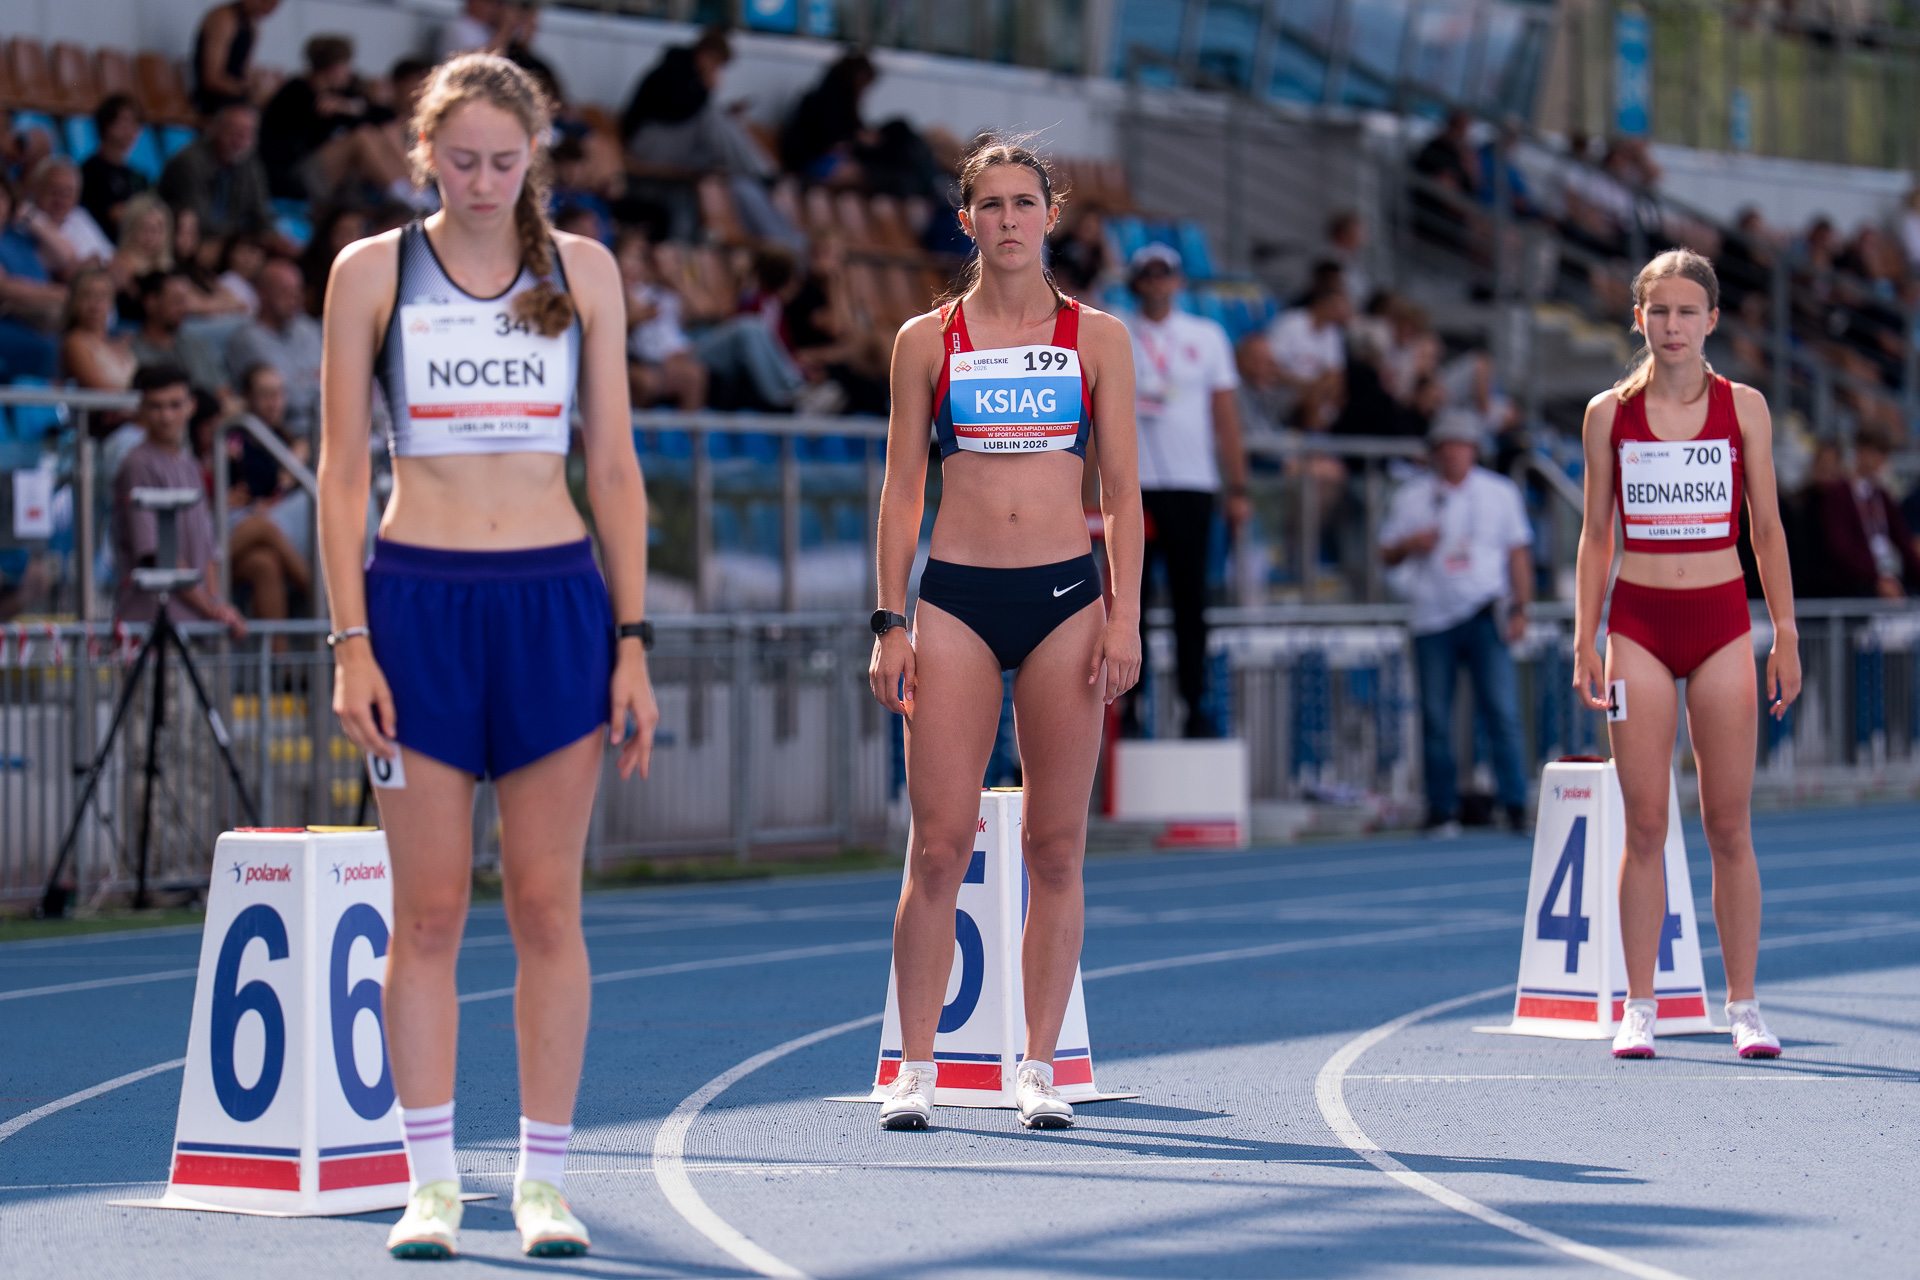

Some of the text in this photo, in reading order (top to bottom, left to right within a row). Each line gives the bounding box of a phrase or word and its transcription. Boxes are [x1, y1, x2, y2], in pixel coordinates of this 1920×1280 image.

[428, 353, 544, 387] NOCEŃ
[973, 357, 1009, 365] LUBELSKIE
[1023, 351, 1068, 371] 199
[975, 388, 1056, 418] KSIĄG
[983, 440, 1048, 449] LUBLIN 2026
[1683, 446, 1722, 466] 700
[1627, 481, 1727, 503] BEDNARSKA
[1648, 527, 1680, 536] LUBLIN
[245, 862, 292, 886] polanik
[344, 861, 386, 886] polanik
[1537, 815, 1589, 974] 4
[210, 903, 289, 1122] 6
[329, 902, 398, 1121] 6
